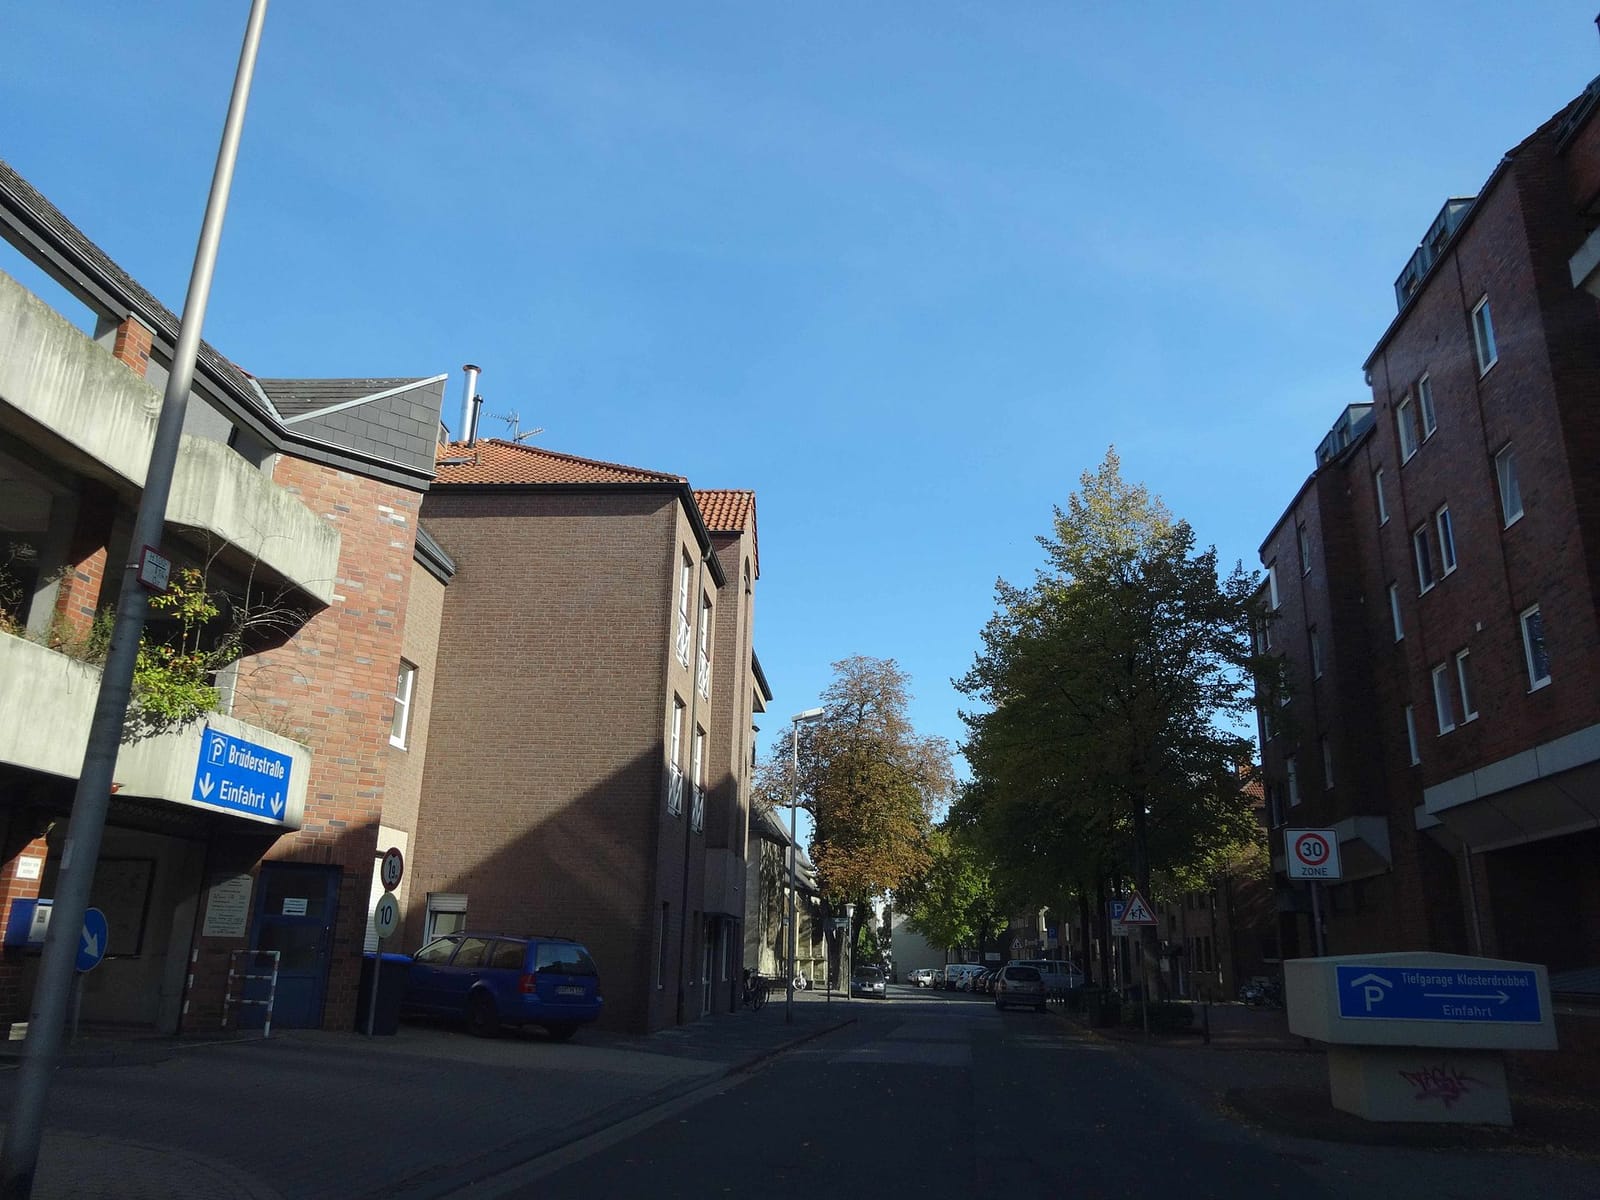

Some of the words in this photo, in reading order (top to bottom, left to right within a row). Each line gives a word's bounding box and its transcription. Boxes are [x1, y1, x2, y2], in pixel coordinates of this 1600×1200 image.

[228, 745, 285, 779] Brüderstraße
[219, 780, 266, 809] Einfahrt
[1302, 841, 1322, 857] 30
[1302, 867, 1328, 876] ZONE
[380, 905, 392, 925] 10
[1113, 903, 1124, 917] P
[1401, 972, 1453, 988] Tiefgarage
[1457, 972, 1529, 987] Klosterdrubbel
[1364, 985, 1385, 1011] P
[1442, 1004, 1492, 1017] Einfahrt
